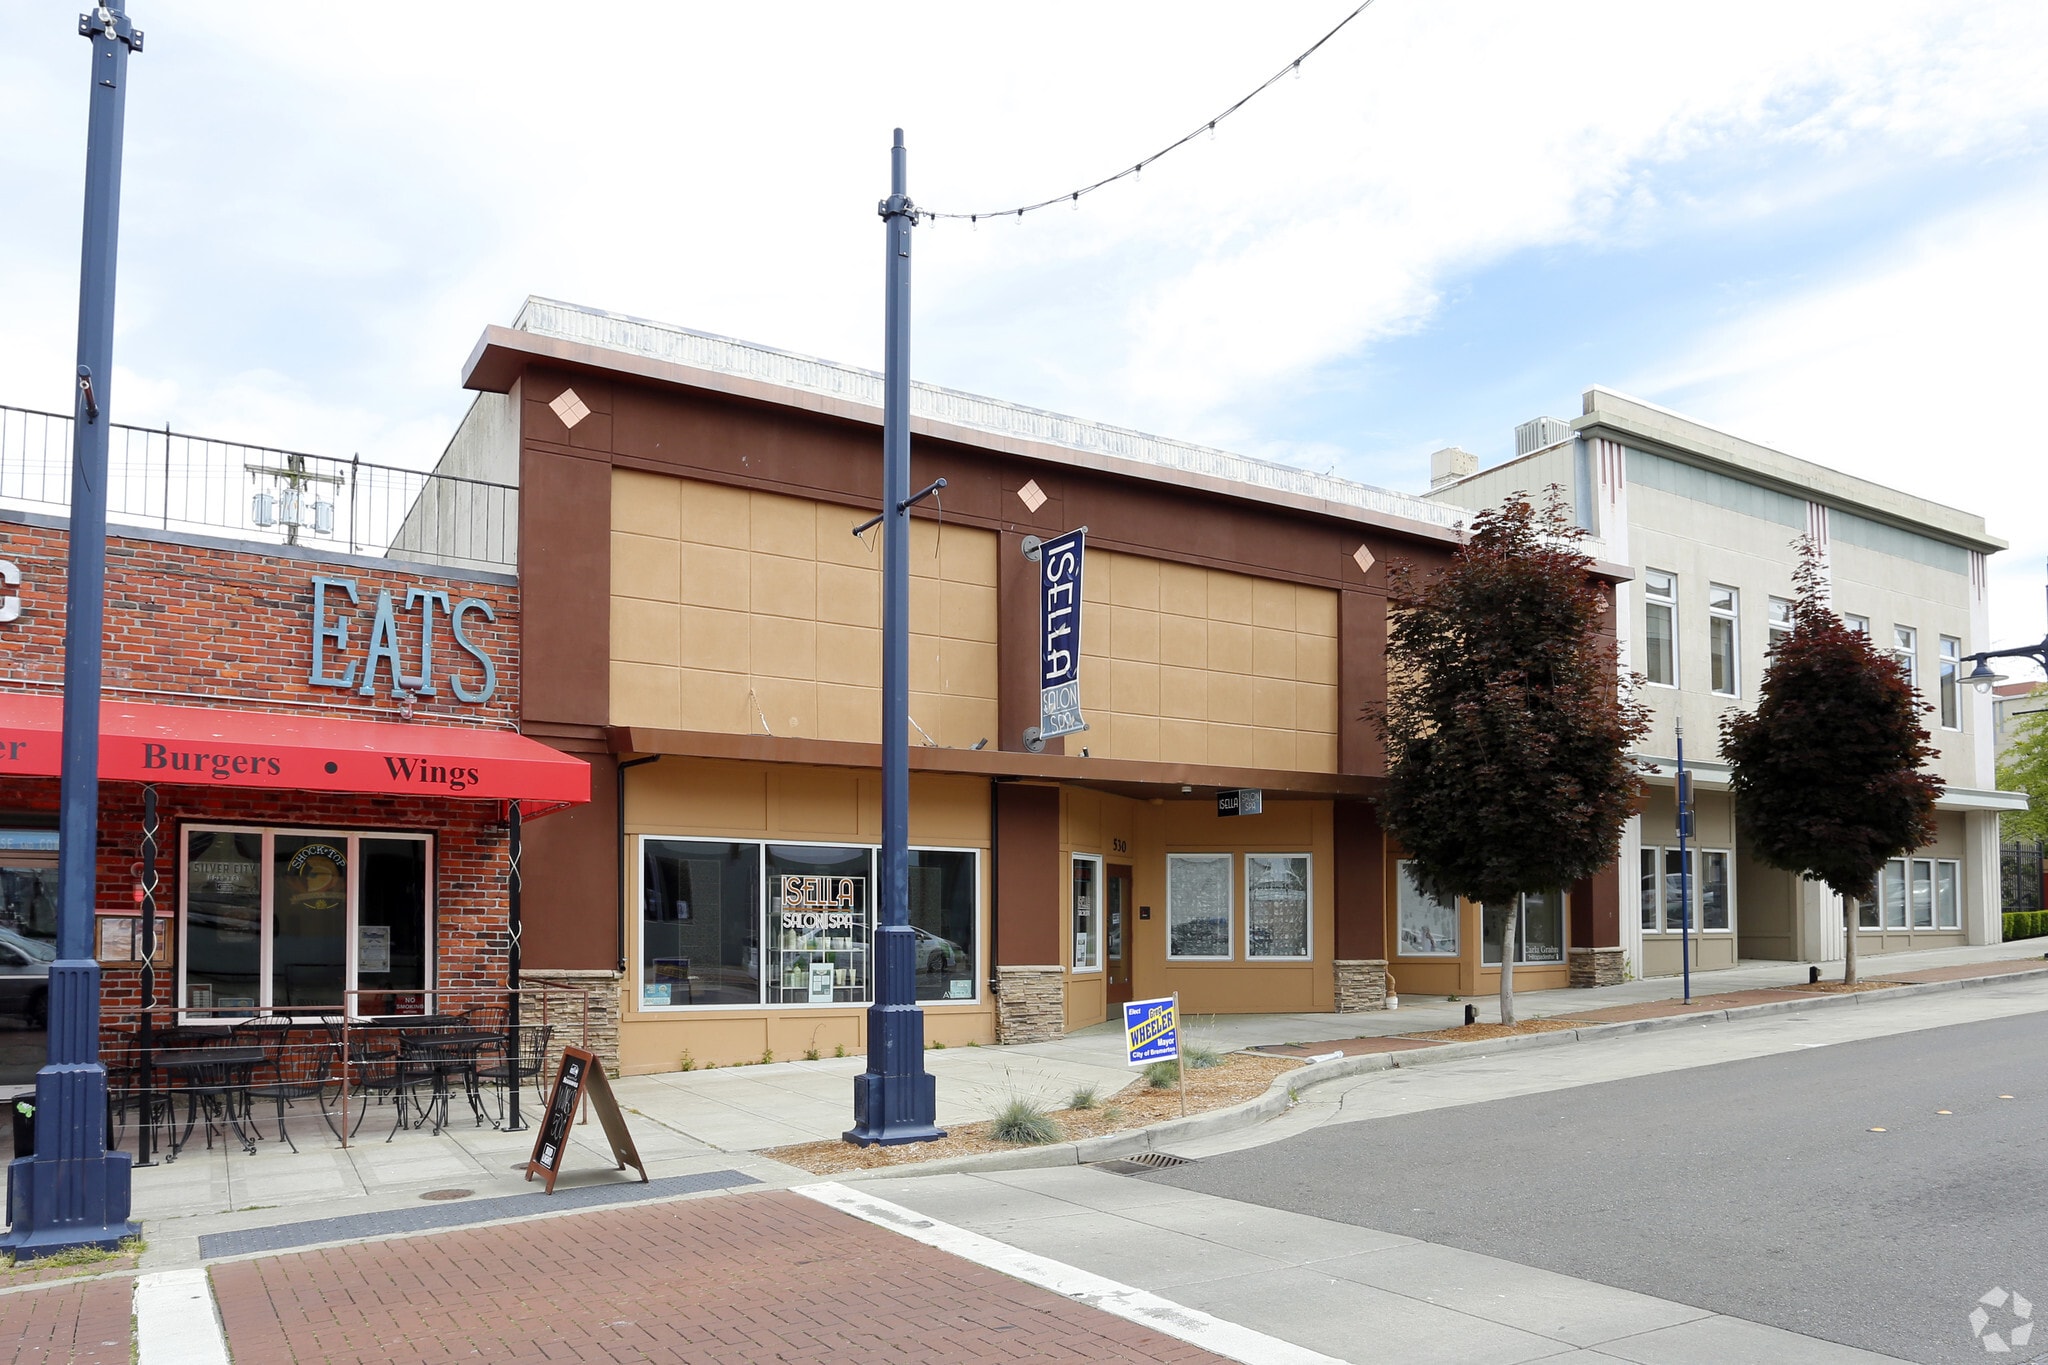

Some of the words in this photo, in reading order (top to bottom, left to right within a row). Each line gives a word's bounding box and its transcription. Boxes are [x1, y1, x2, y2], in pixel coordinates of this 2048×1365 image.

[1046, 540, 1076, 680] ISELLA
[308, 575, 496, 703] EATS
[1043, 684, 1077, 714] SALON
[1050, 711, 1076, 733] SPA
[141, 743, 281, 780] Burgers
[383, 756, 479, 791] Wings
[1219, 797, 1239, 809] ISELLA
[1241, 792, 1260, 801] SALON
[1244, 801, 1256, 811] SPA
[1112, 838, 1127, 853] 530
[291, 846, 325, 869] SHOCK
[327, 849, 346, 867] TOP
[194, 863, 230, 874] SILVER
[233, 863, 256, 874] CITY
[781, 876, 854, 906] ISELLA
[783, 913, 824, 928] SALON
[828, 914, 853, 928] SPA
[1149, 1005, 1162, 1018] Greg
[1130, 1011, 1173, 1047] WHEELER
[1157, 1038, 1175, 1047] Mayor
[1132, 1051, 1143, 1059] City
[1150, 1047, 1176, 1056] Bremerton
